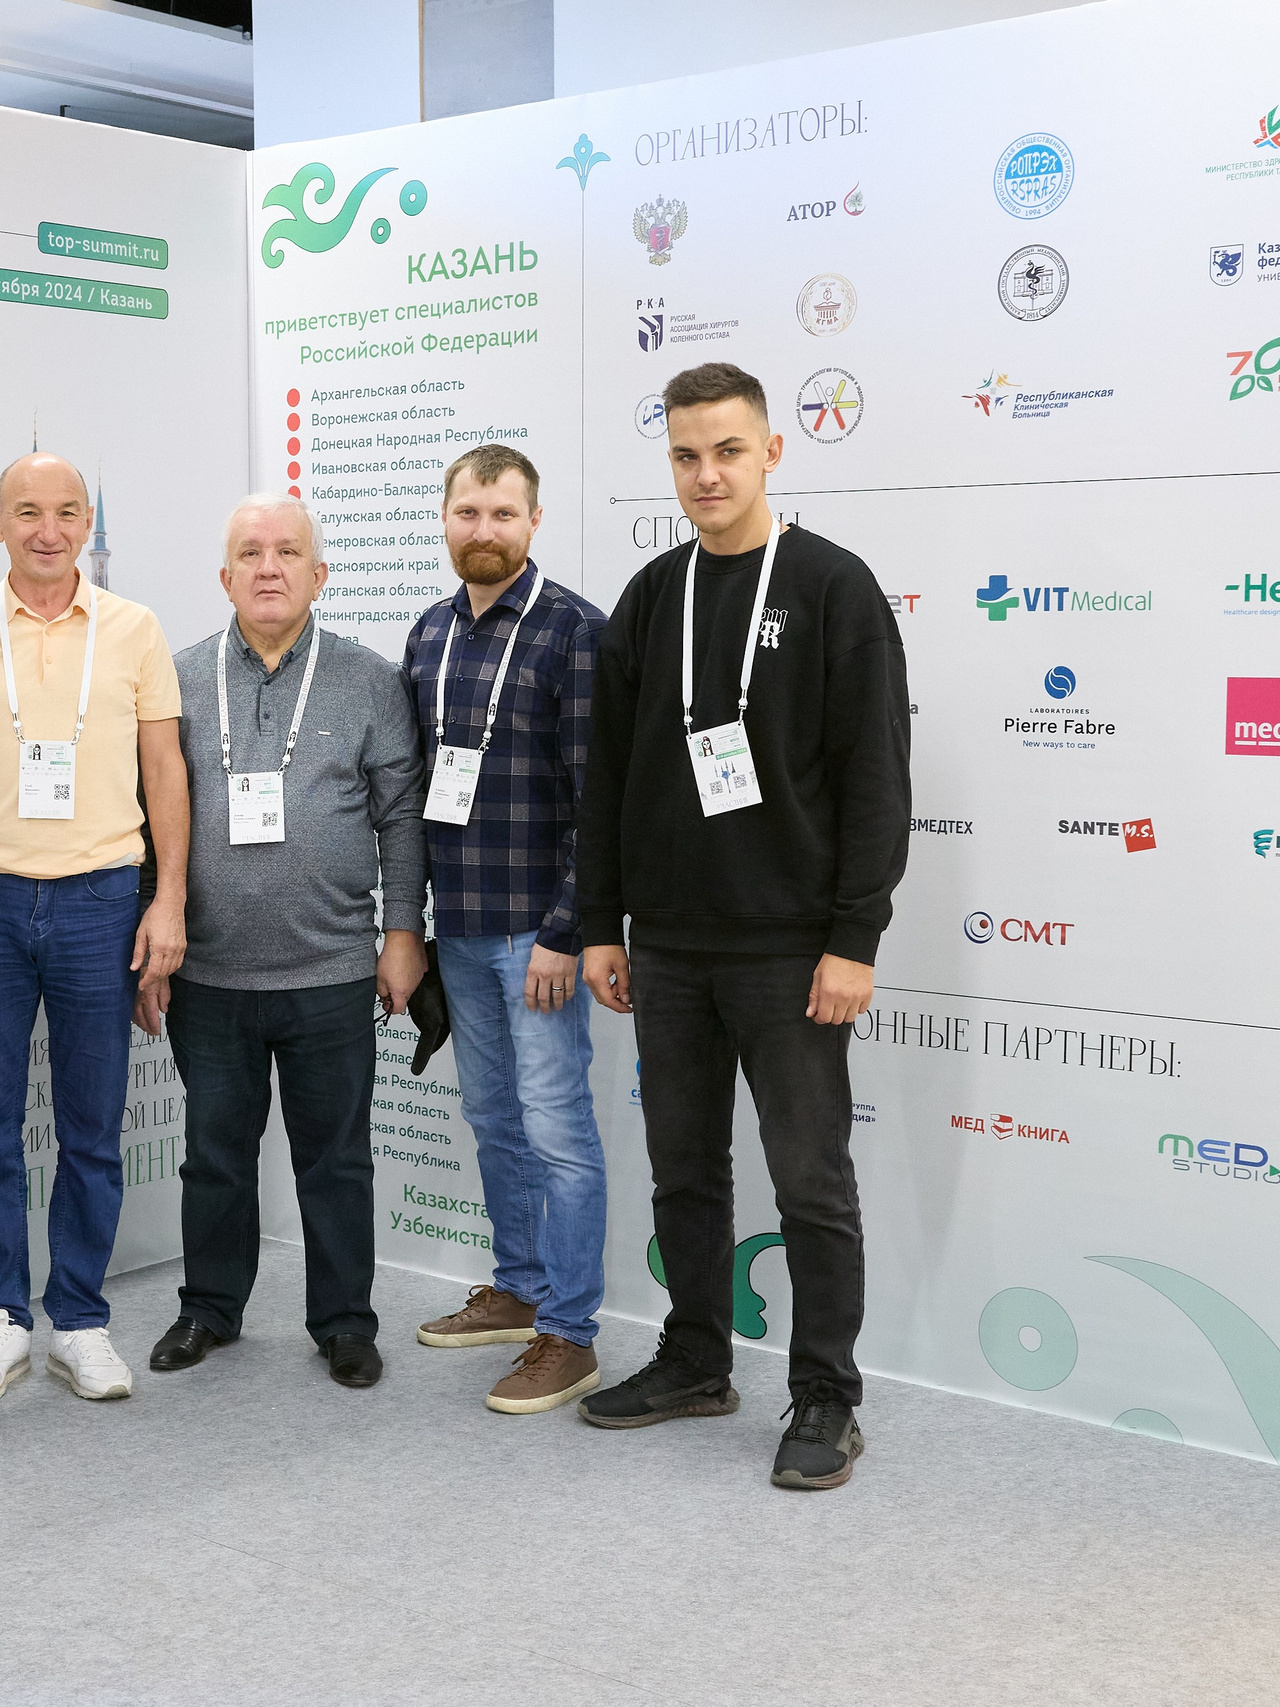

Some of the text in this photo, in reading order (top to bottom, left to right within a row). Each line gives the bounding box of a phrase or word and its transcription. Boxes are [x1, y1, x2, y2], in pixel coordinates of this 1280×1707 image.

[635, 100, 869, 166] ОРГАНИЗАТОРЫ:
[1205, 160, 1263, 173] МИНИСТЕРСТВО
[1226, 169, 1274, 181] РЕСПУБЛИКИ
[787, 200, 836, 221] АТОР
[47, 230, 160, 263] top-summit.ru
[407, 240, 538, 284] КАЗАНЬ
[44, 281, 83, 303] 2024
[100, 287, 153, 311] Казань
[265, 291, 538, 339] приветствует специалистов
[670, 314, 696, 322] РУССКАЯ
[670, 320, 739, 333] АССОЦИАЦИЯ ХИРУРГОВ
[704, 331, 730, 340] СУСТАВА
[300, 327, 538, 365] Российской Федерации
[311, 378, 465, 405] Архангельская область
[1015, 389, 1114, 403] Республиканская
[1012, 411, 1050, 419] Больница
[1014, 402, 1069, 411] Клиническая
[311, 405, 455, 429] Воронежская область
[311, 425, 528, 454] Донецкая Народная Республика
[311, 456, 444, 476] Ивановская область
[312, 483, 445, 502] Кабардино-Балкарск
[317, 507, 438, 527] алужская область
[323, 532, 445, 551] емеровская област
[329, 558, 439, 575] асноярский край
[389, 583, 442, 596] область
[1023, 587, 1152, 611] VIT Medical
[313, 608, 410, 625] Ленинградская
[1004, 717, 1116, 736] Pierre Fabre
[1023, 739, 1039, 748] New
[1042, 741, 1064, 751] ways
[1078, 742, 1096, 750] care
[910, 818, 973, 835] ВМЕДТЕХ
[1058, 819, 1120, 837] SANTE
[377, 1024, 420, 1042] бласть
[853, 1008, 1181, 1079] ОННЫЕ ПАРТНЕРЫ:
[375, 1049, 414, 1065] облас
[391, 1074, 462, 1098] Республик
[397, 1101, 450, 1120] область
[399, 1125, 451, 1145] область
[951, 1114, 1070, 1145] МЕД КНИГА
[383, 1144, 461, 1172] Республика
[404, 1183, 489, 1218] Казахста
[390, 1210, 492, 1250] Узбекиста
